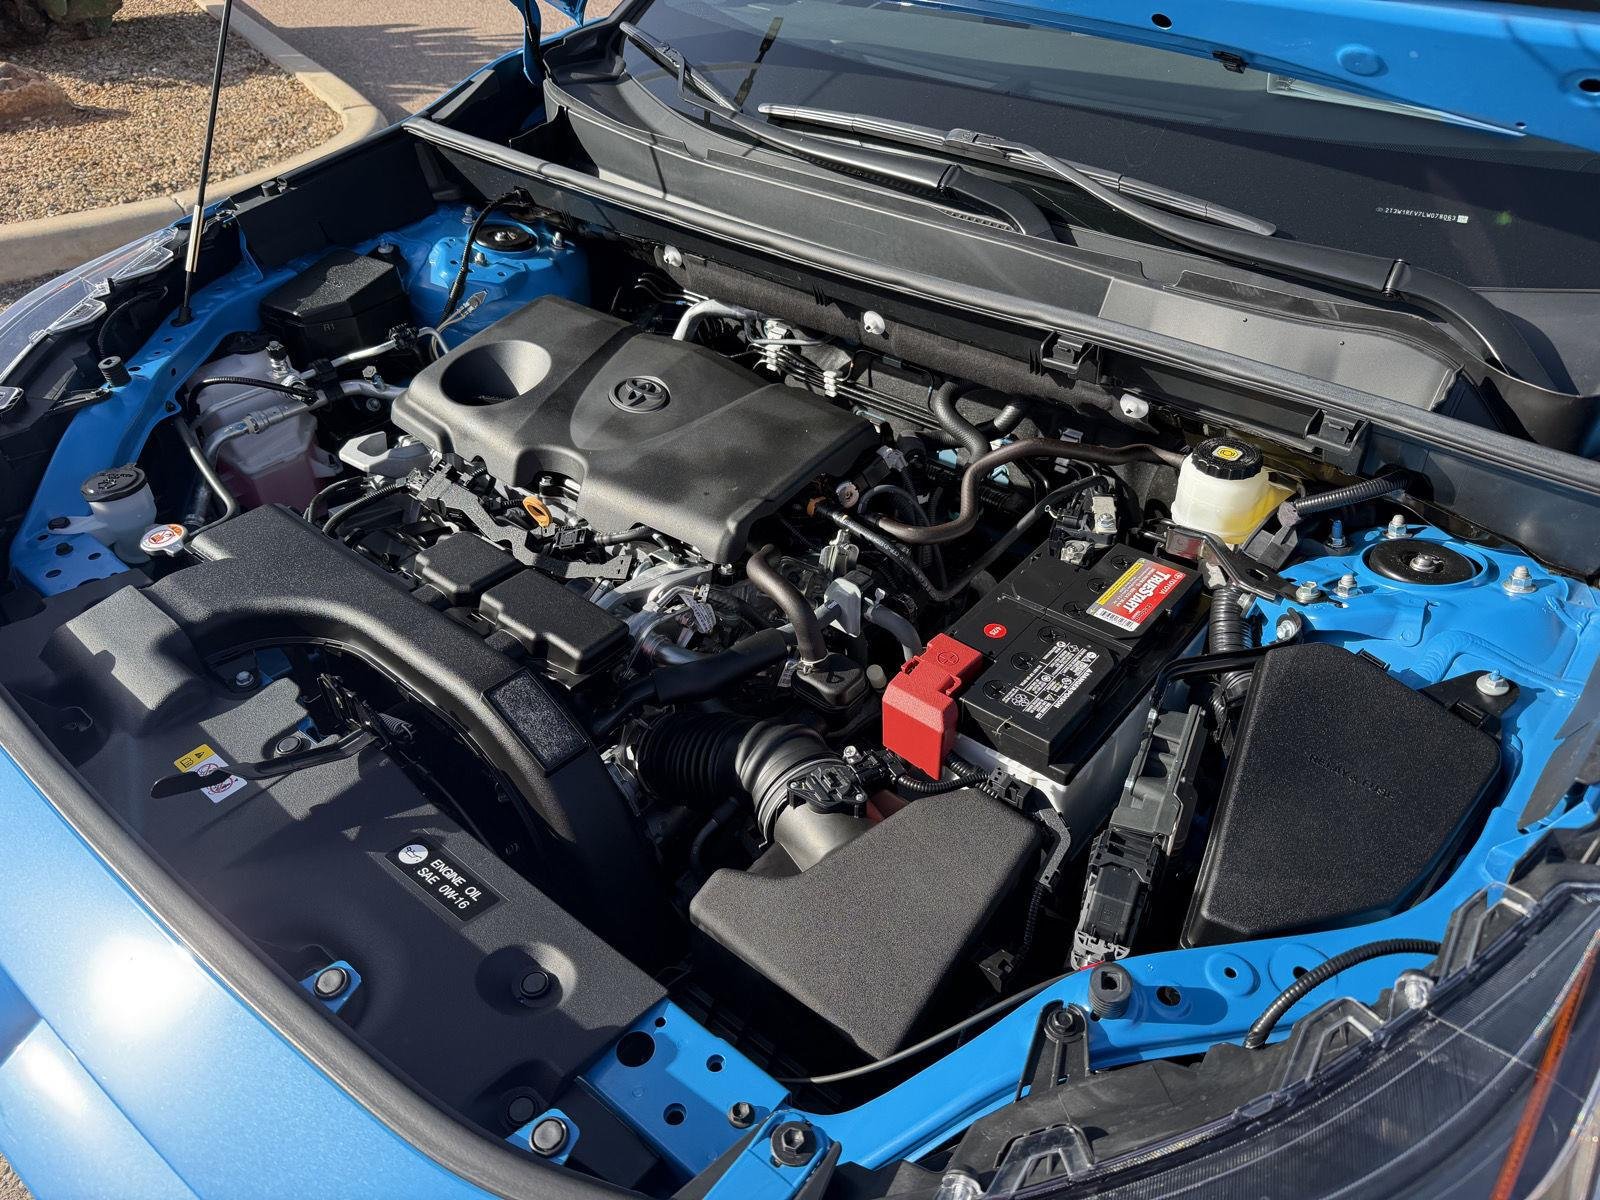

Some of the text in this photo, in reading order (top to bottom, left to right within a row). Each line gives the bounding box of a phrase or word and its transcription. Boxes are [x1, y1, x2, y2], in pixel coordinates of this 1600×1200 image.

[1158, 578, 1178, 595] TOYOTA
[417, 867, 470, 909] SAE 0W-16
[430, 858, 483, 901] ENGINE OIL
